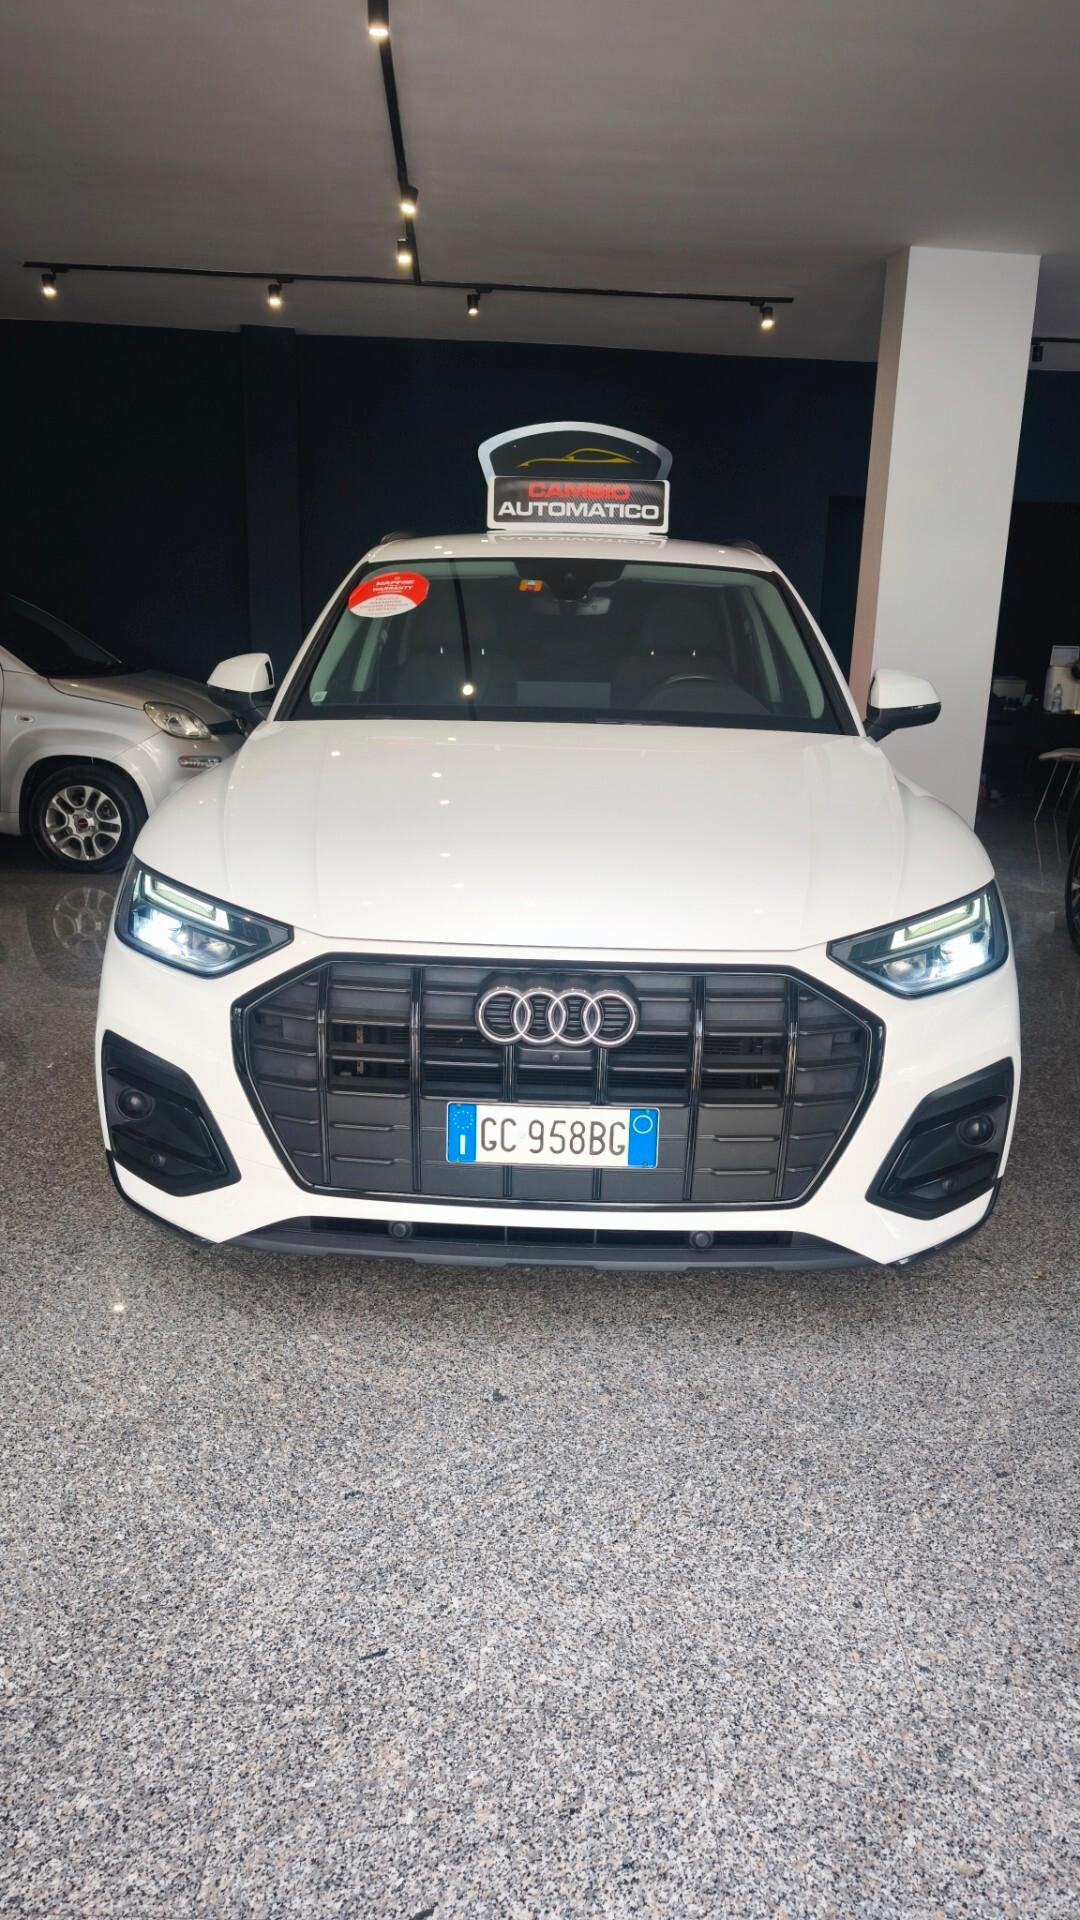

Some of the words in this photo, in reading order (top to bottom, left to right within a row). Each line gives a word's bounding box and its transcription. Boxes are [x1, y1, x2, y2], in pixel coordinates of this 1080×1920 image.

[498, 501, 660, 520] AUTOMATICO
[480, 1116, 517, 1152] GC
[527, 1119, 627, 1156] 958BG
